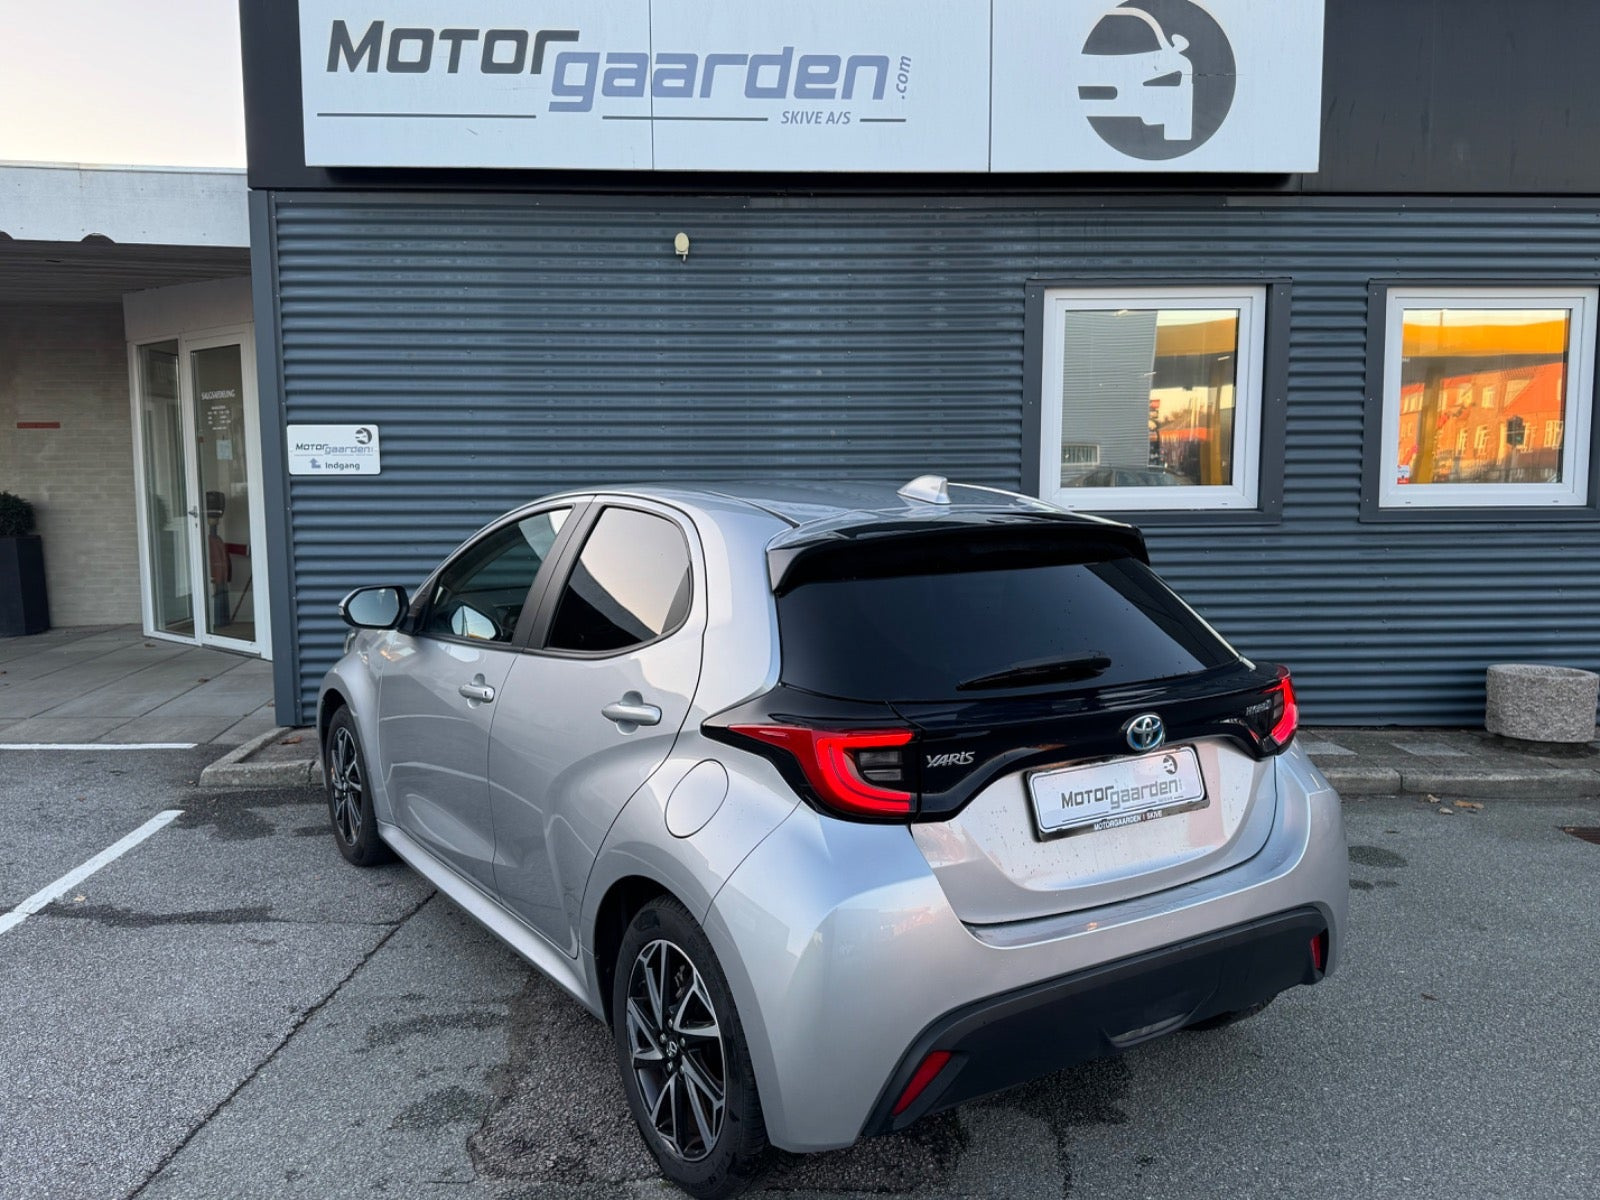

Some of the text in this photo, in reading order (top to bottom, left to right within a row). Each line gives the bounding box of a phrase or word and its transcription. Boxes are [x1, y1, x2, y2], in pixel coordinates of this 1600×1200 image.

[780, 110, 852, 125] SKIVE A/S
[325, 462, 361, 471] Indgang
[1094, 814, 1141, 831] MOTORGAARDEN
